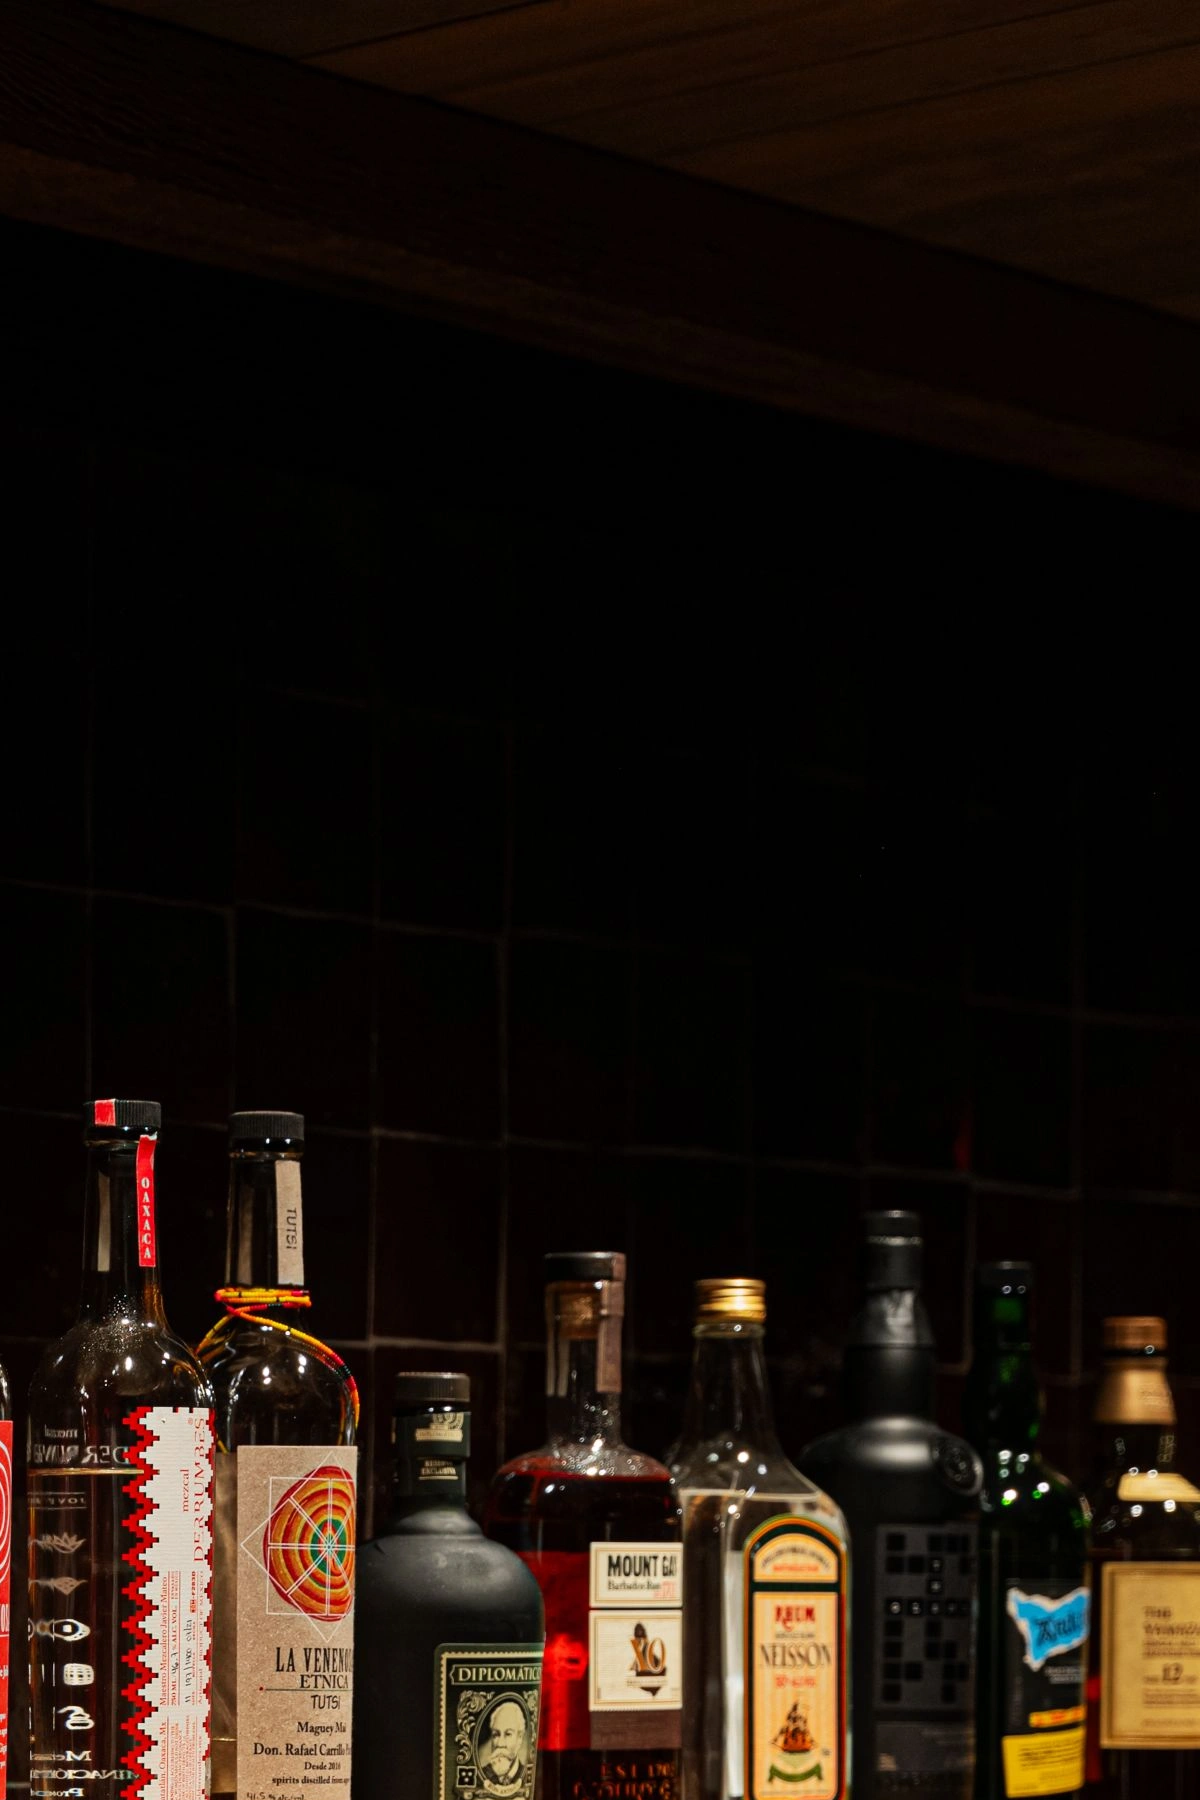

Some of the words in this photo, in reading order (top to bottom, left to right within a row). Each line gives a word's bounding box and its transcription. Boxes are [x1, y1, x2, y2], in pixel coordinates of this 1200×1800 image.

[140, 1177, 153, 1259] OAXACA
[180, 1469, 189, 1512] mezcal
[193, 1418, 205, 1562] DERRUMBES
[607, 1556, 658, 1577] MOUNT
[159, 1576, 168, 1602] Mateo
[159, 1604, 168, 1628] Javier
[159, 1629, 168, 1671] Mezcalero
[275, 1647, 296, 1673] LA
[630, 1637, 667, 1673] XO
[759, 1641, 832, 1670] NEISSON
[159, 1671, 168, 1706] Maestro
[299, 1674, 349, 1690] ETNICA
[296, 1721, 334, 1737] Maguey
[285, 1742, 317, 1756] Rafael
[303, 1761, 327, 1771] Desde
[272, 1775, 300, 1787] spirits
